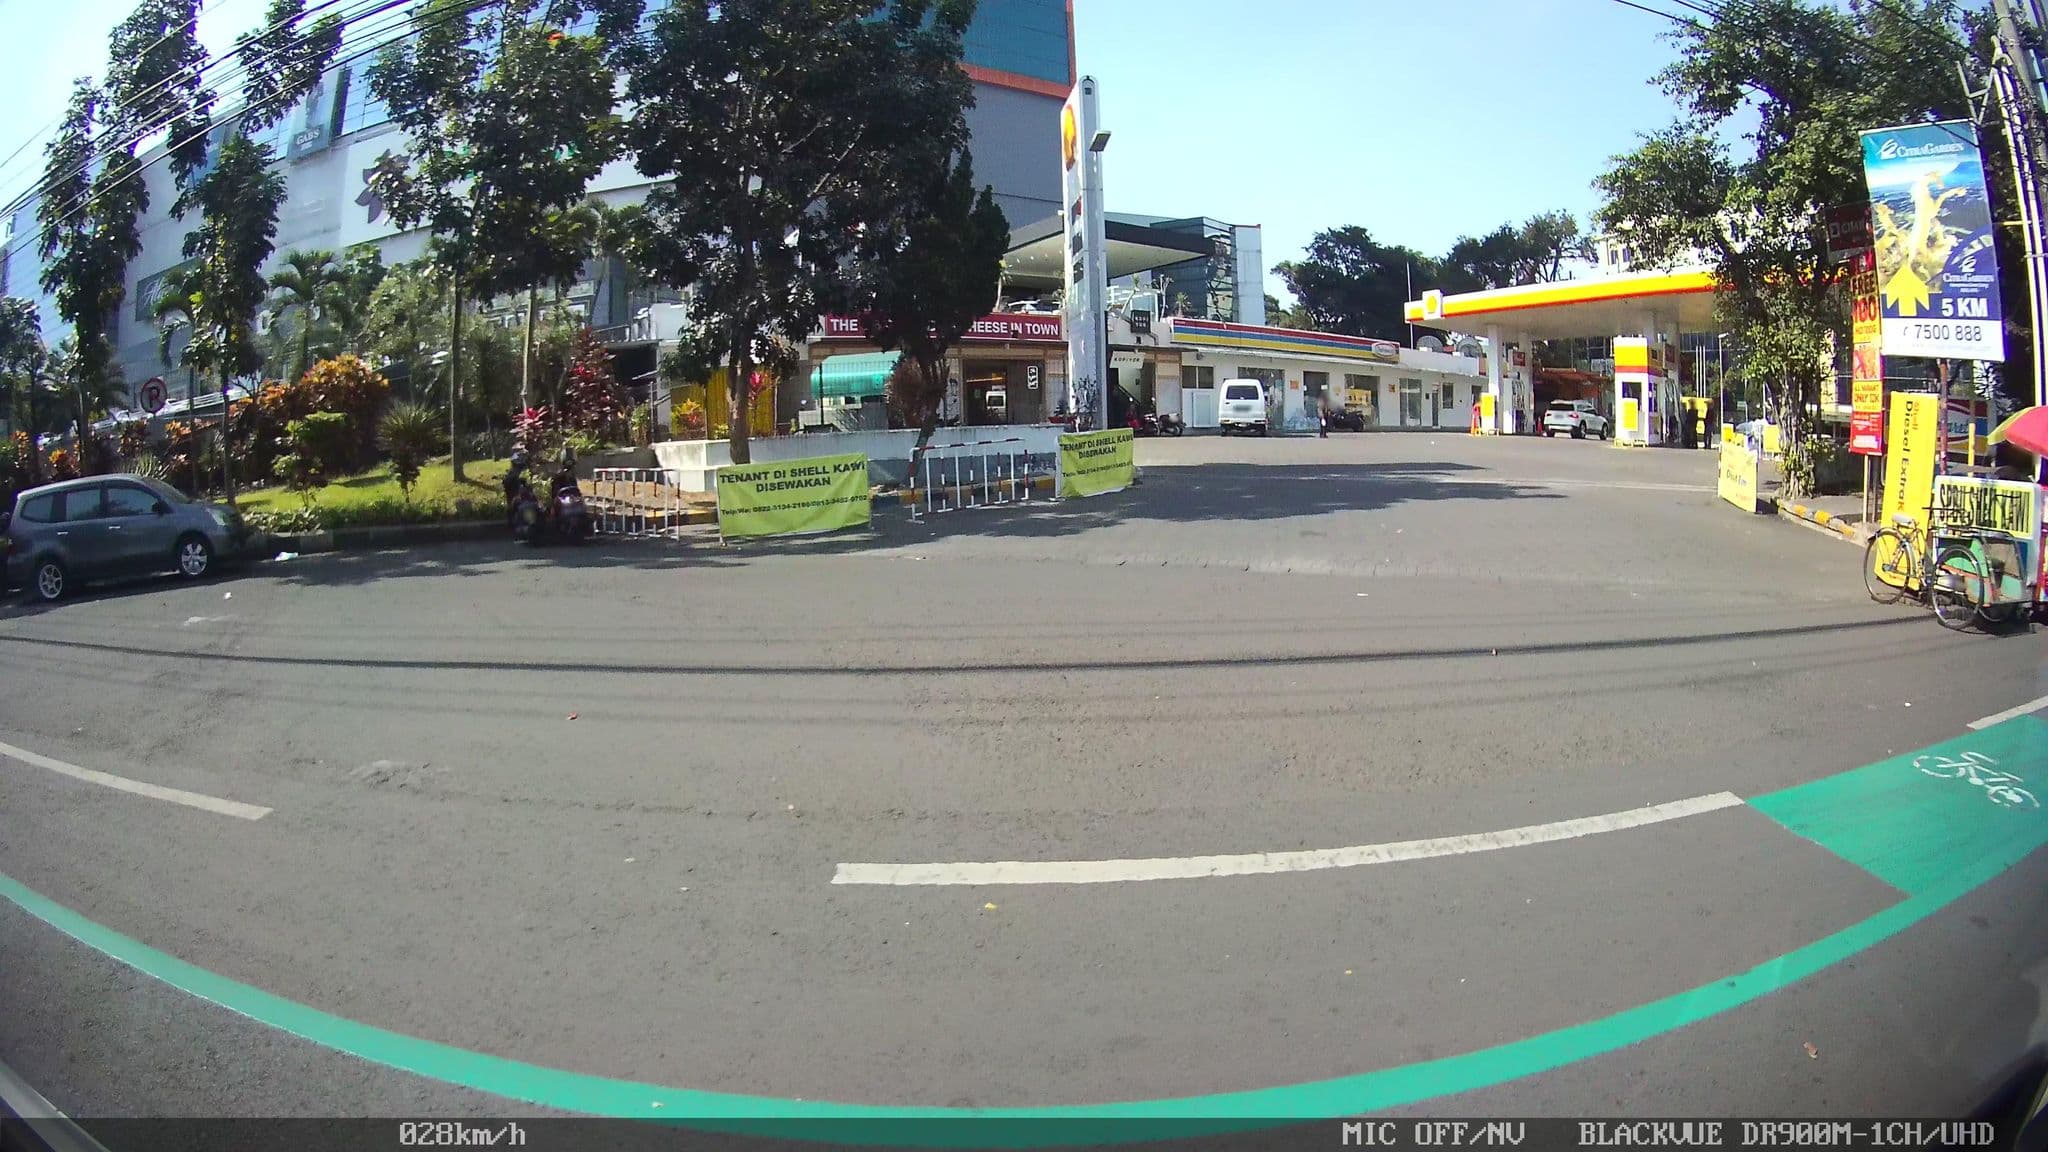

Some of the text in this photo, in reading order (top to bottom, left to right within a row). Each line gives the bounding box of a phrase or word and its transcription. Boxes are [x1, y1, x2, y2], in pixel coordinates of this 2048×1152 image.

[1941, 297, 1989, 317] 5 KM
[830, 318, 1059, 336] THE HEESE IN TOWN
[1914, 324, 1982, 341] 7500 888
[1902, 400, 1914, 452] Diesel
[720, 461, 865, 484] TENANT DI SHELL KAWI
[756, 477, 831, 493] DISEWAKAN
